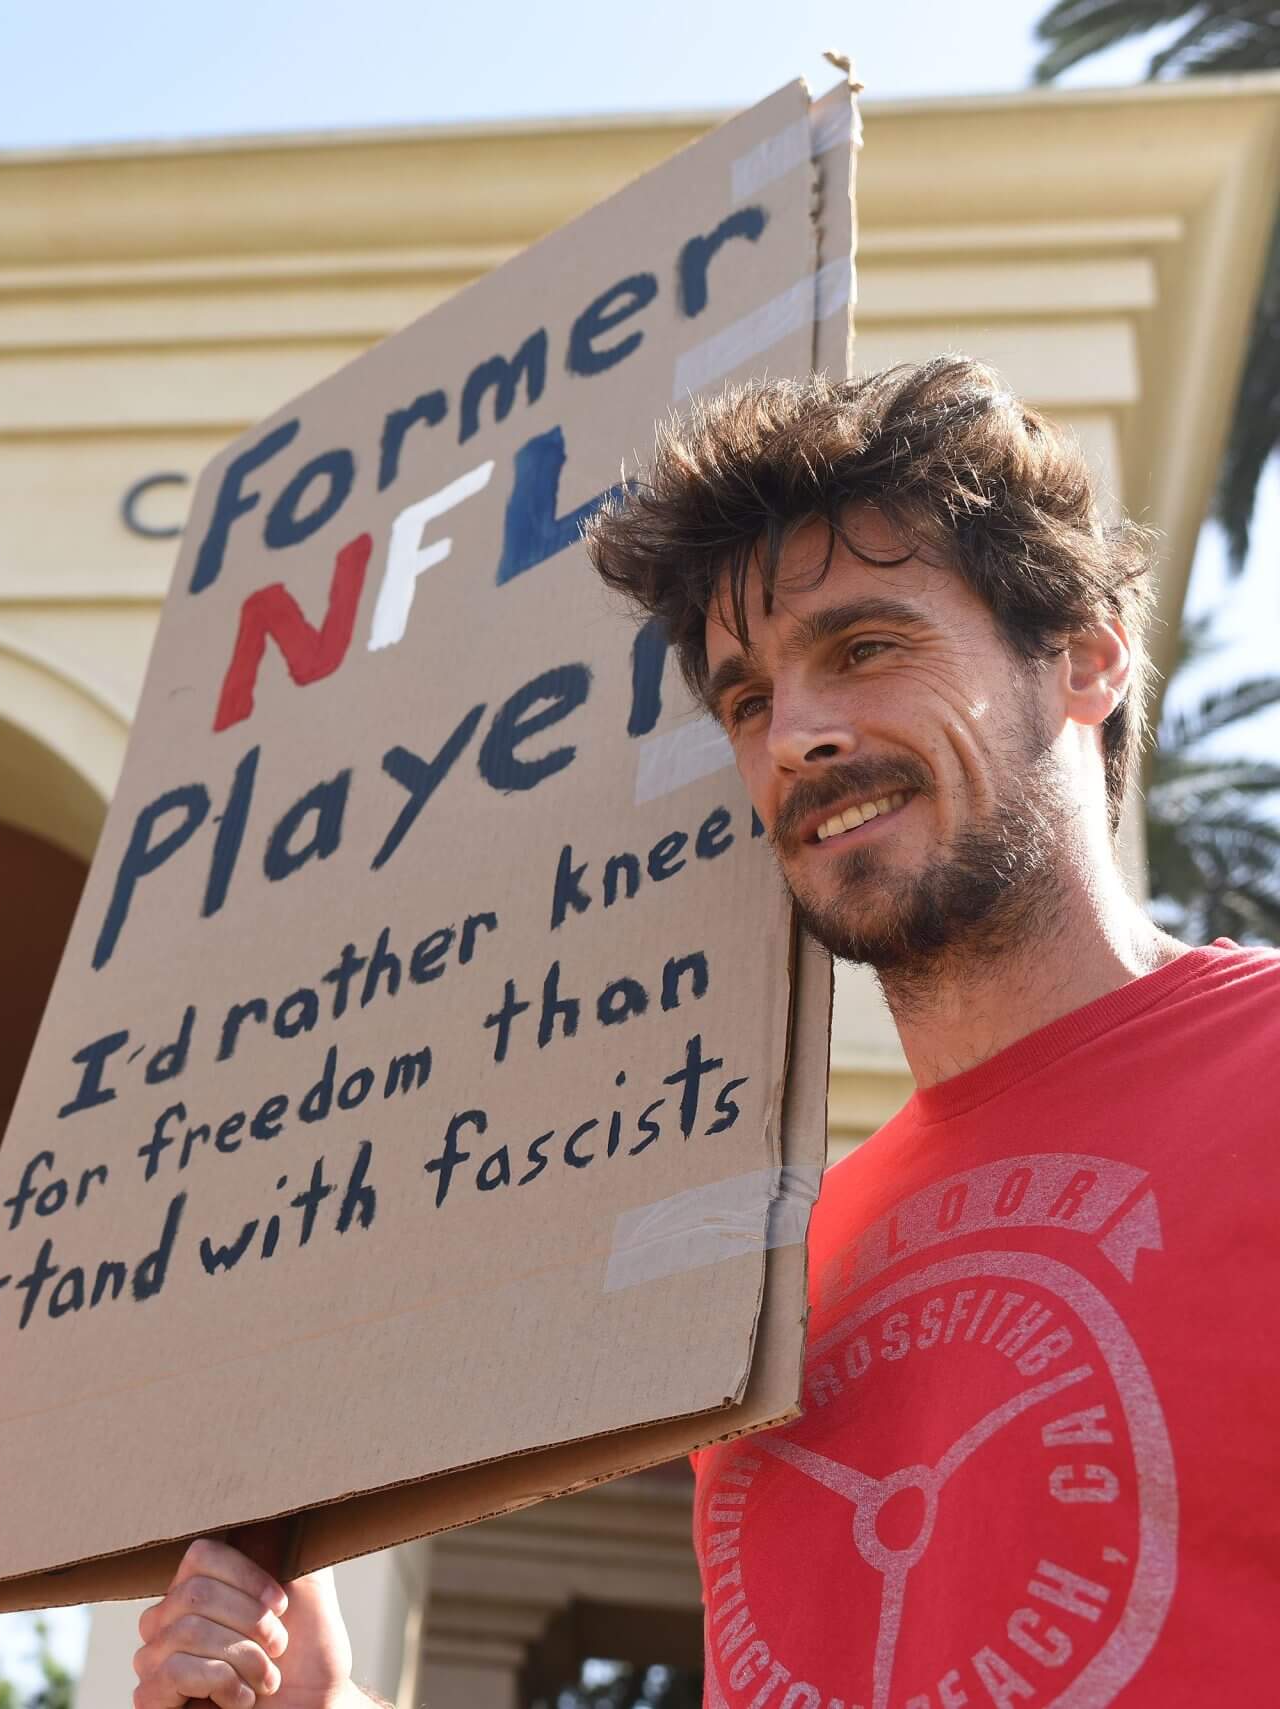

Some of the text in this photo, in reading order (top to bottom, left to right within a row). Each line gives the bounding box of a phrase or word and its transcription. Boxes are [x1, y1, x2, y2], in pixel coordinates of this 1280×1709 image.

[189, 205, 770, 595] Former
[213, 425, 638, 733] NFL
[3, 950, 710, 1231] for freedom than
[57, 805, 764, 1118] I'd rather knee
[200, 1141, 378, 1276] with
[424, 1033, 751, 1206] fascists
[798, 1288, 1074, 1418] ROSSFITHB
[1041, 1404, 1120, 1504] CA
